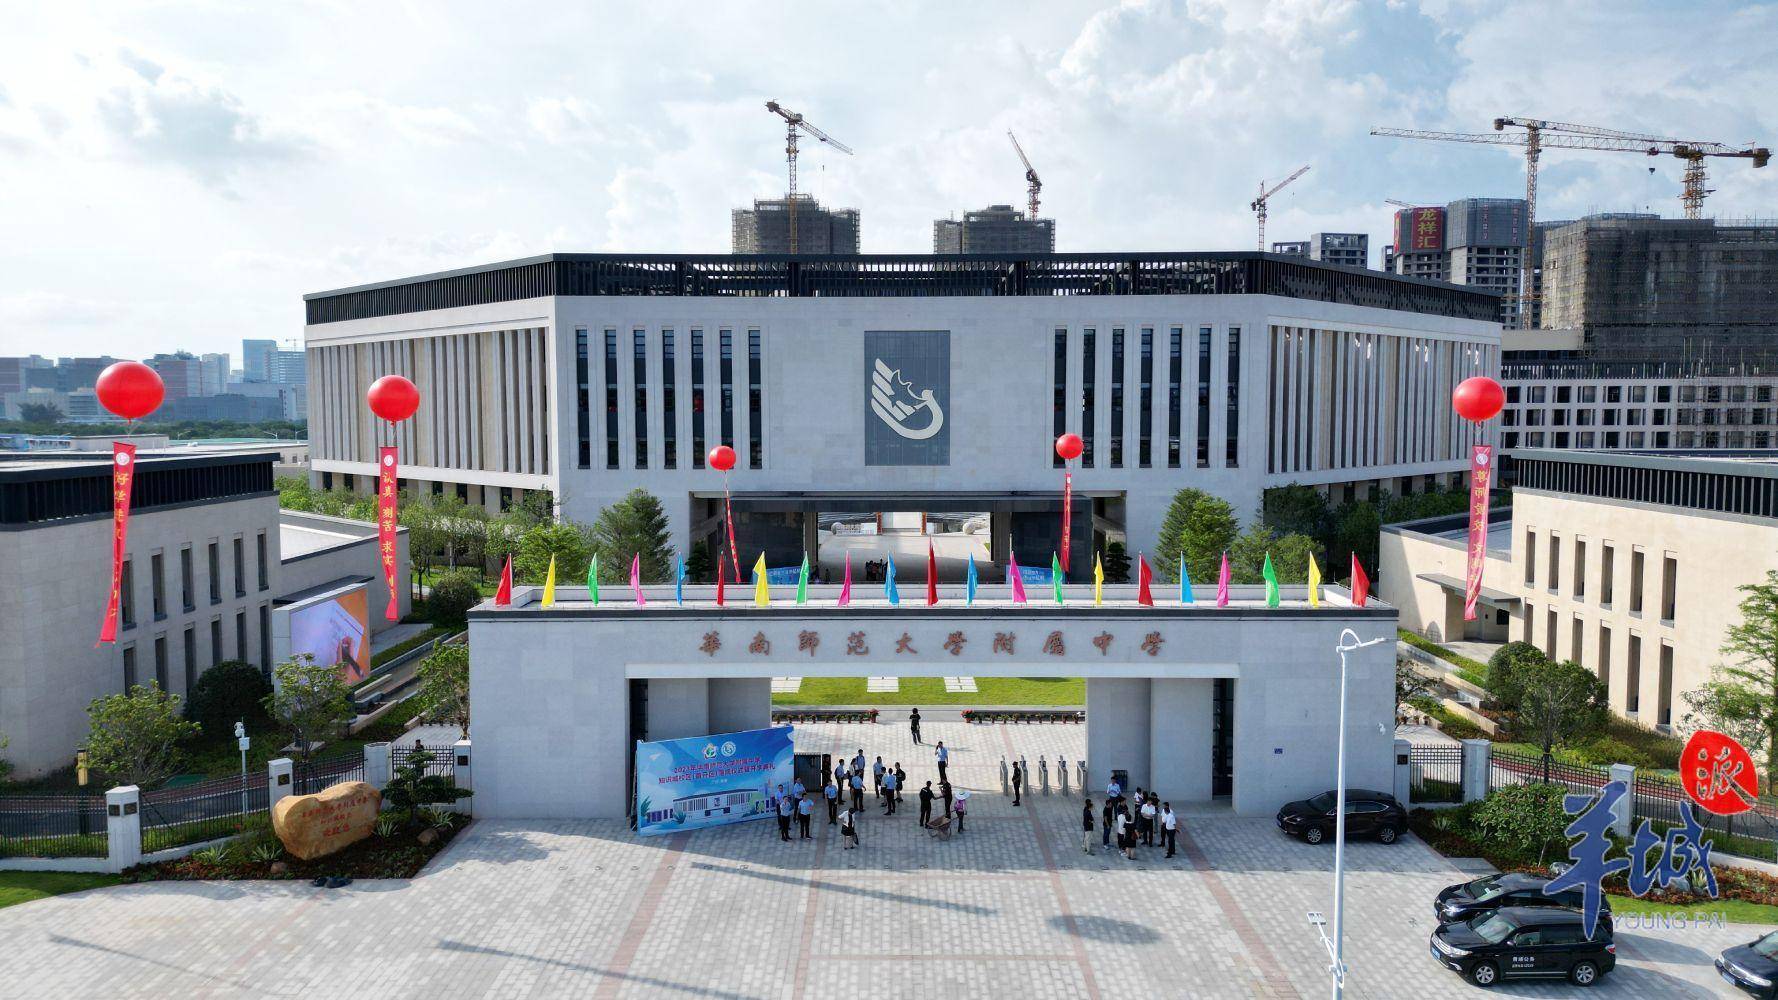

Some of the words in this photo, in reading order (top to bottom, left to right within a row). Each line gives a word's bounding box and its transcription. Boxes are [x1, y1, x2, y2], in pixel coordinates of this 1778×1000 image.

[1417, 208, 1437, 248] 龙祥汇
[382, 473, 394, 499] 认真
[382, 506, 394, 532] 刻苦
